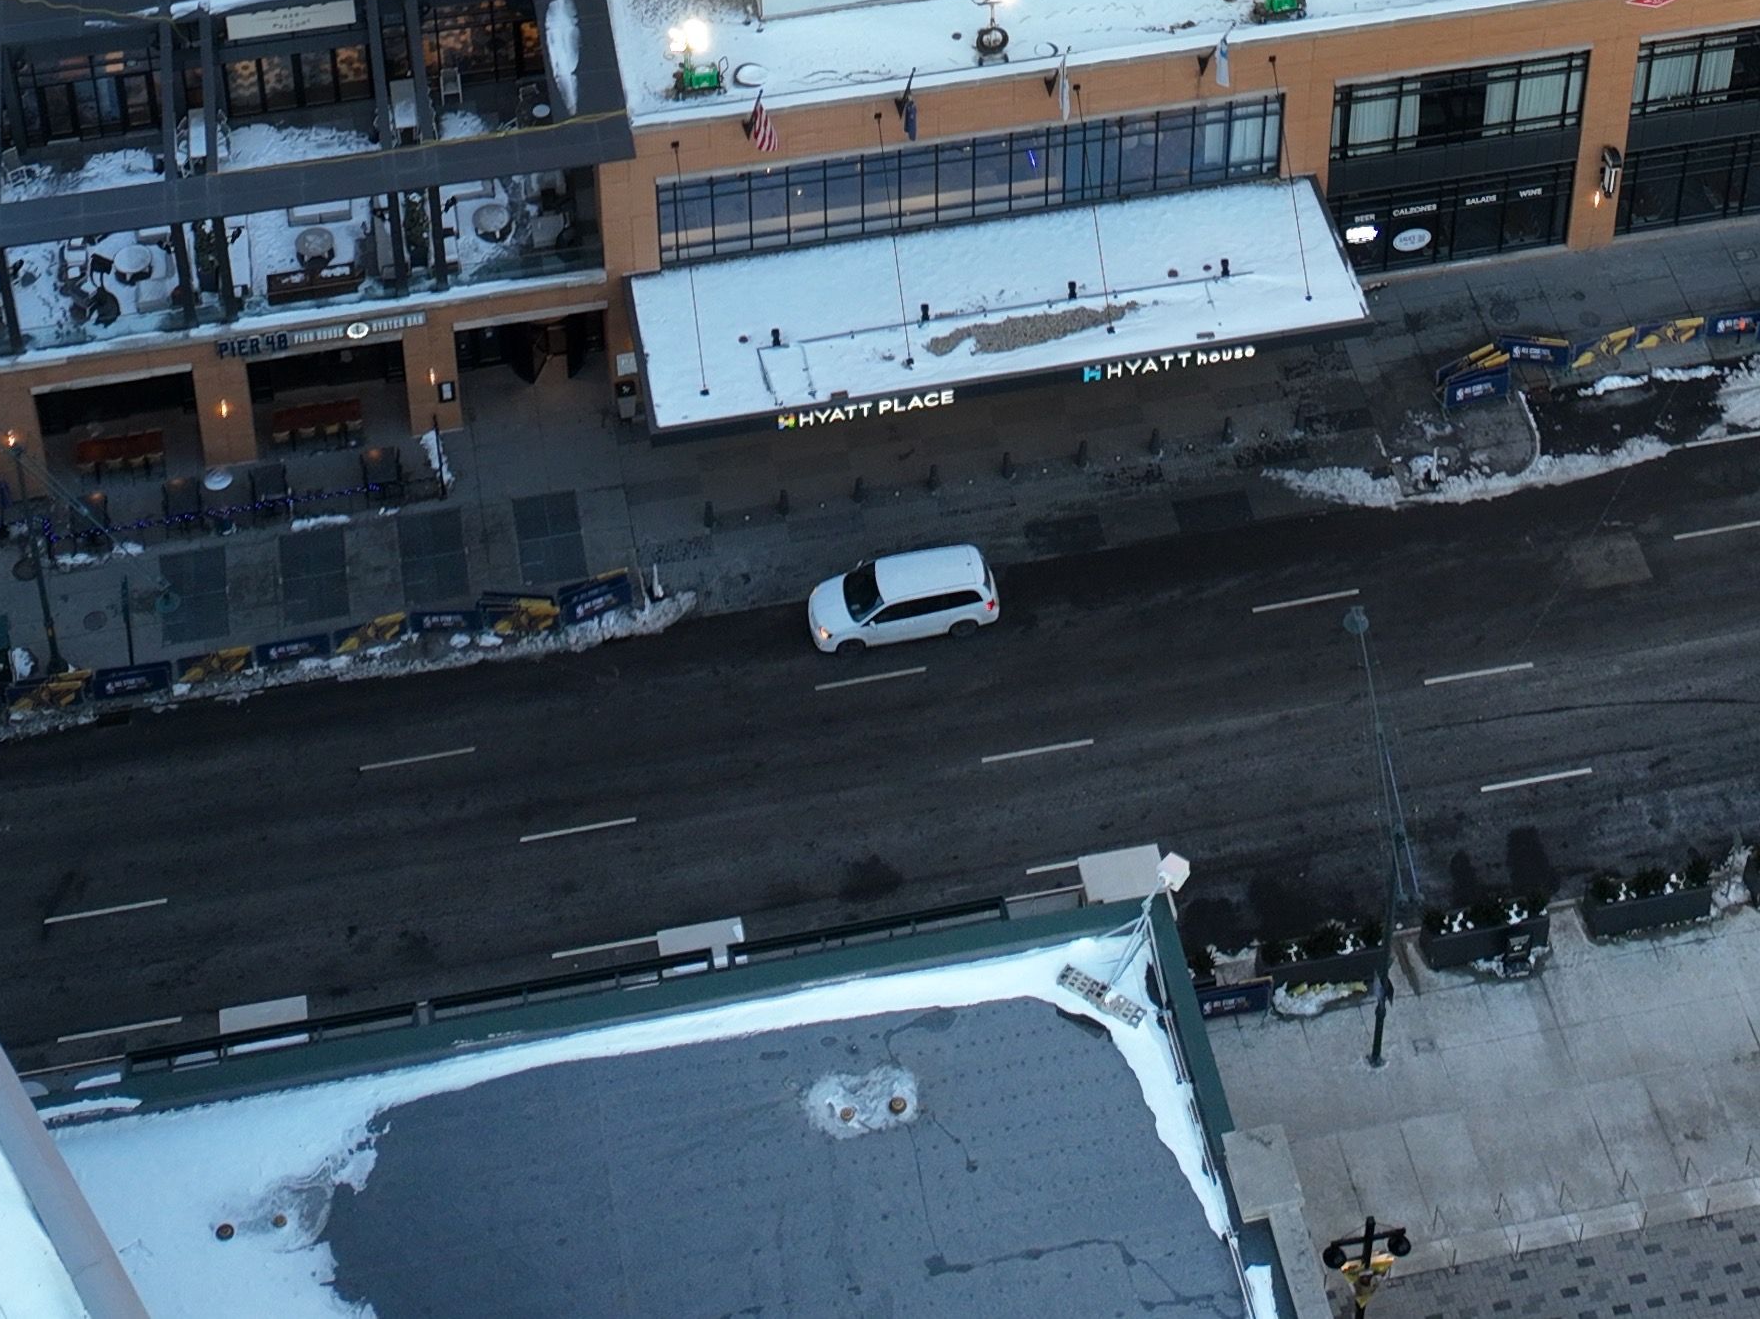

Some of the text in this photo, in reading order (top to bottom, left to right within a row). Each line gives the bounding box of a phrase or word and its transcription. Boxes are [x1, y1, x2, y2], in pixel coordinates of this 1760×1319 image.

[1519, 188, 1542, 198] WINE
[1465, 195, 1497, 206] SALADS
[1393, 204, 1438, 218] CALZONES
[1354, 214, 1376, 224] BEER
[218, 336, 261, 358] PIER
[1106, 345, 1256, 380] HYATT house
[798, 390, 956, 428] HYATT PLACE
